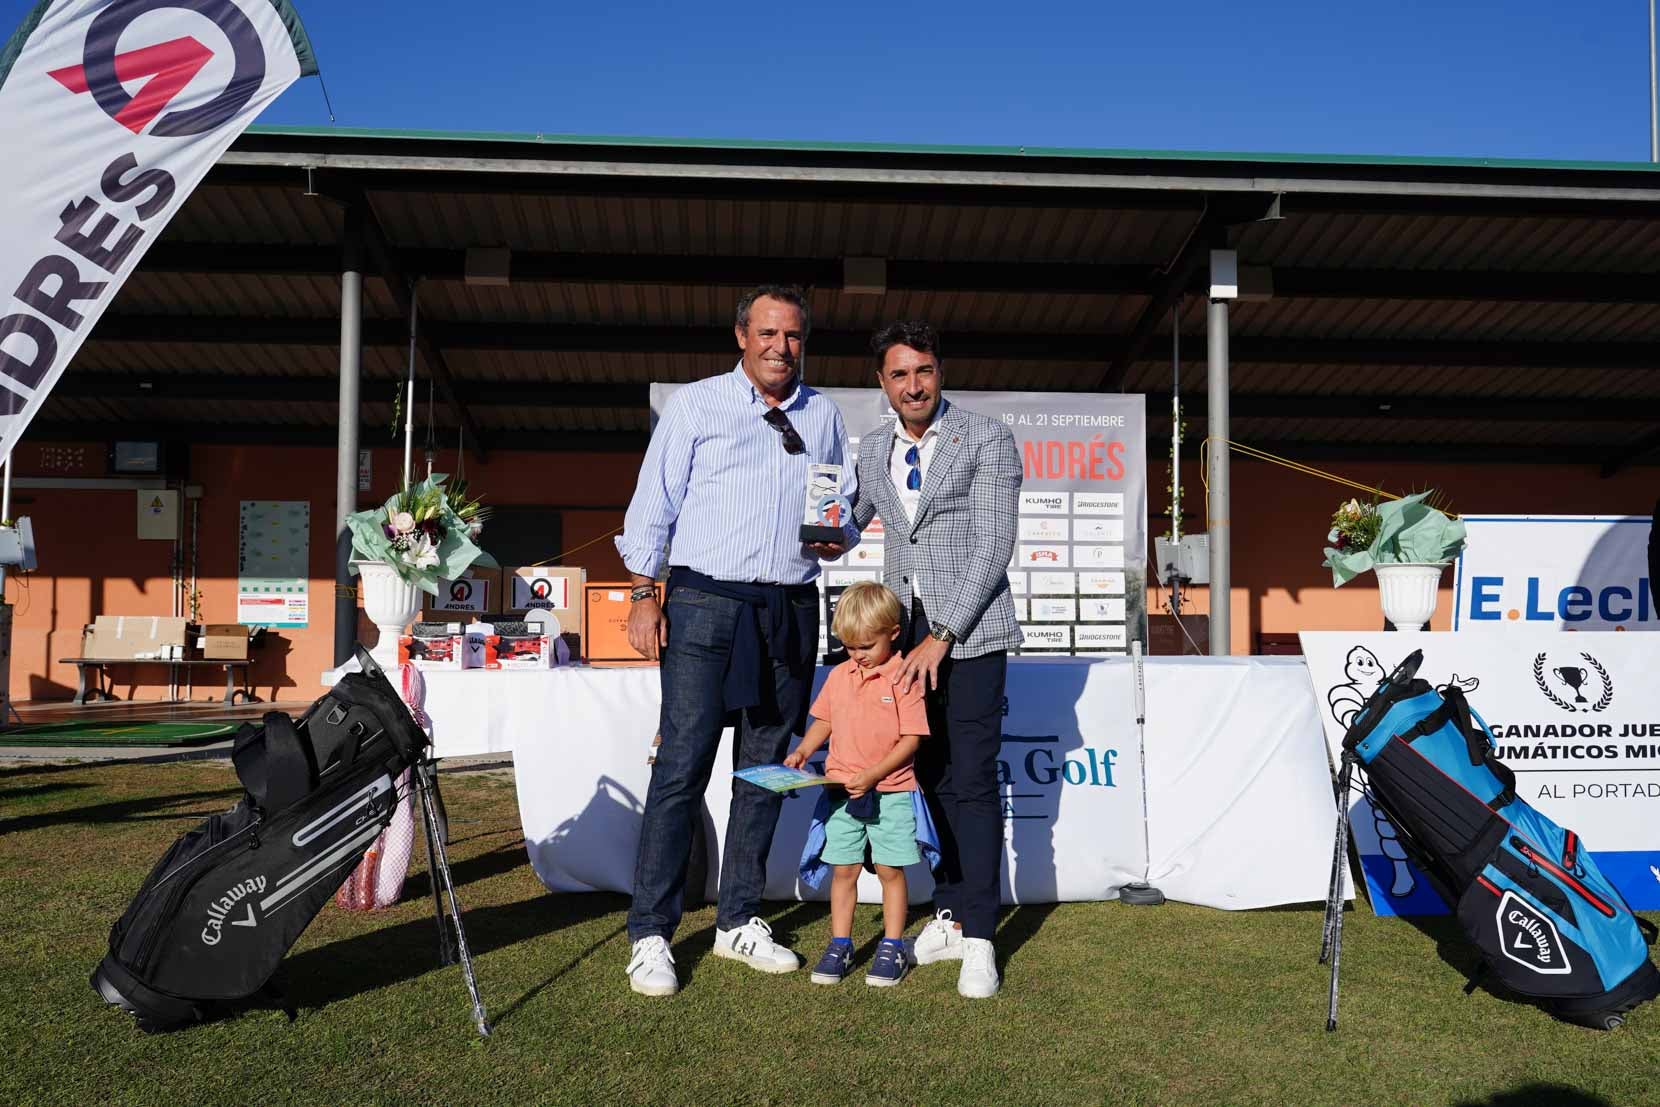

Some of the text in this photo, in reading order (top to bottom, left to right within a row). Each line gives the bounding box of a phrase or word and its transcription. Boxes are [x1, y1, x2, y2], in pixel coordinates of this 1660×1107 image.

[1018, 414, 1033, 426] AL
[1036, 414, 1048, 426] 21
[1051, 415, 1125, 427] SEPTIEMBRE
[1023, 433, 1126, 481] NDRÉS
[1469, 576, 1649, 622] E.Lecl
[1489, 724, 1613, 738] GANADOR
[1024, 747, 1118, 788] Golf
[1537, 784, 1566, 799] AL
[201, 874, 267, 946] Callaway
[1508, 909, 1552, 963] Callaway
